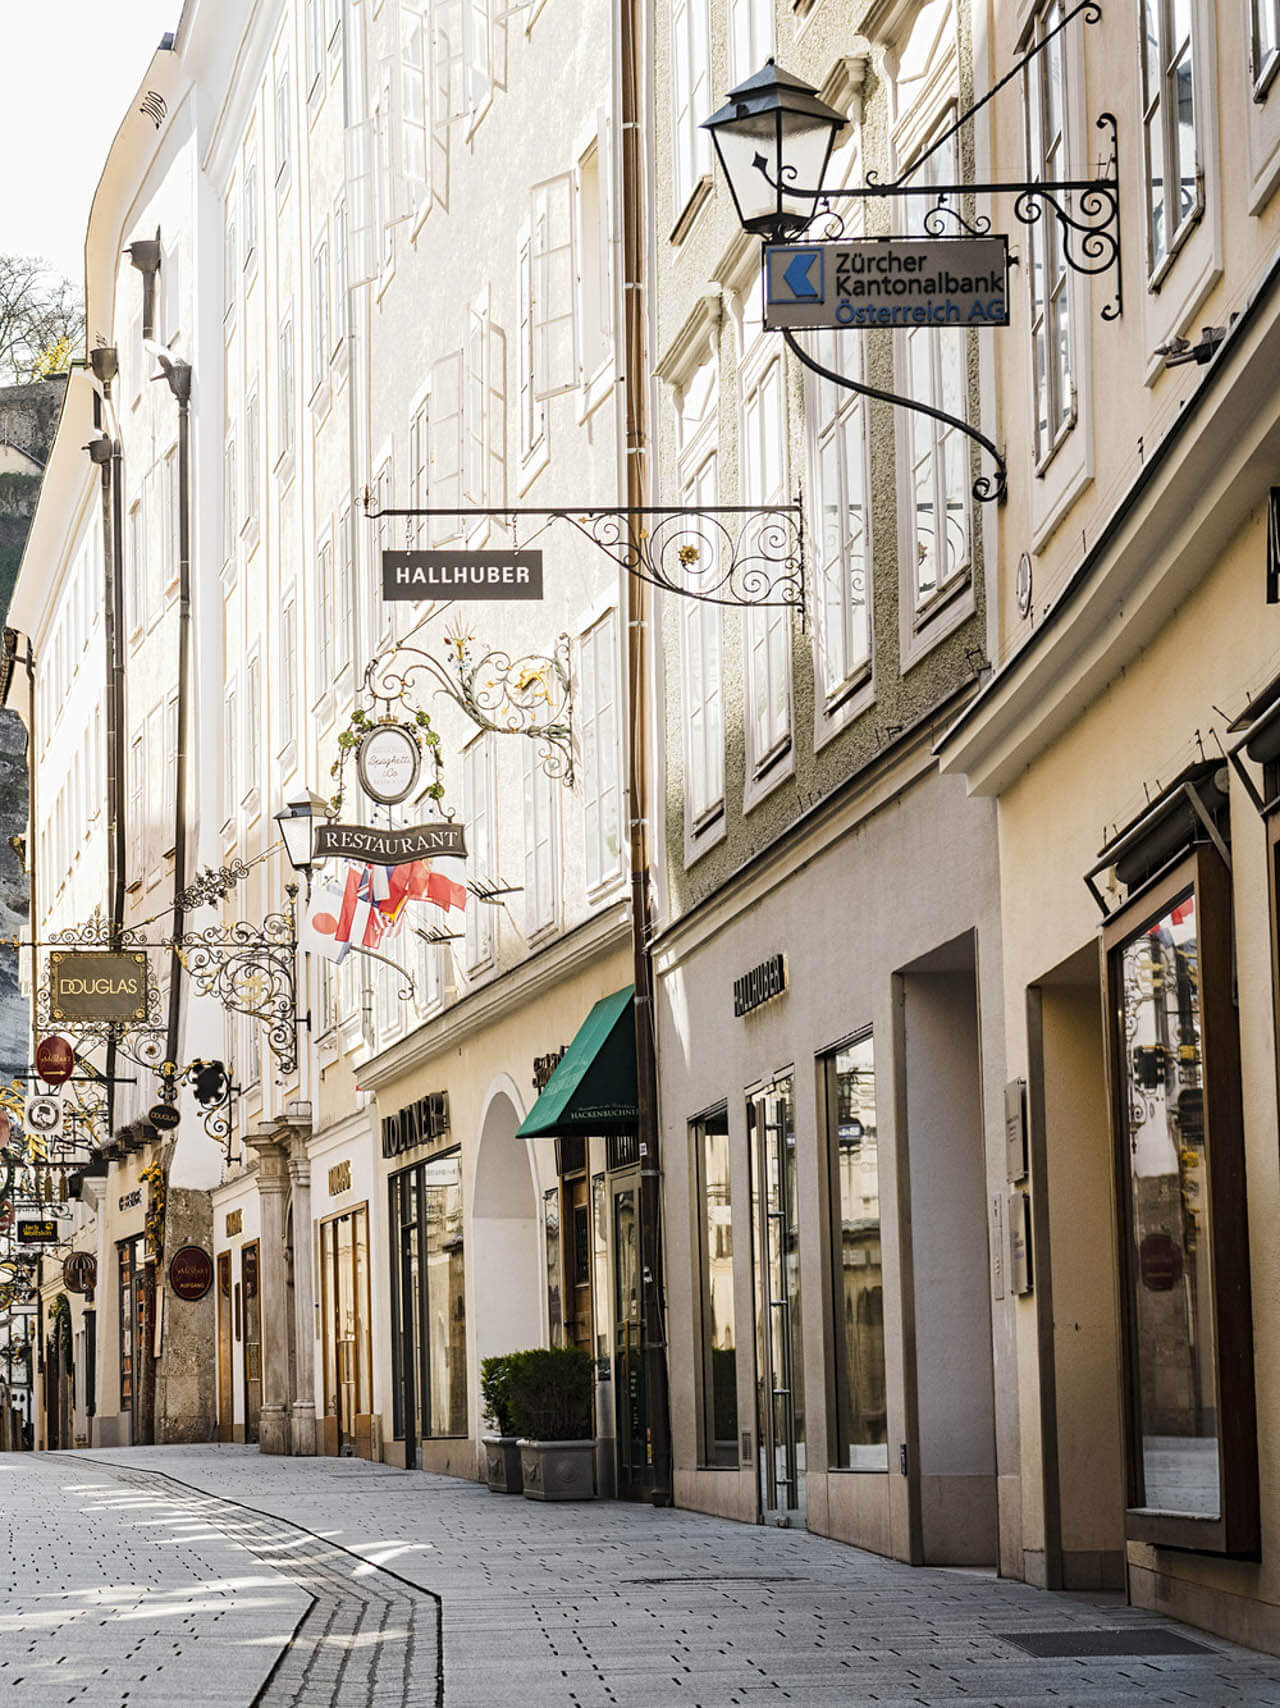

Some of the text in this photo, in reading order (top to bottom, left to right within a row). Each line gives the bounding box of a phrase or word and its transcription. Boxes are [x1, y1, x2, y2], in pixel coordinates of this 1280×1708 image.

[835, 251, 928, 274] Zürcher
[835, 272, 1005, 297] Kantonalbank
[834, 297, 1006, 324] Österreich AG
[396, 566, 530, 584] HALLHUBER
[326, 831, 458, 854] RESTAURANT
[60, 979, 138, 994] DOUGLAS
[570, 1108, 639, 1120] HACKENBUCHNE
